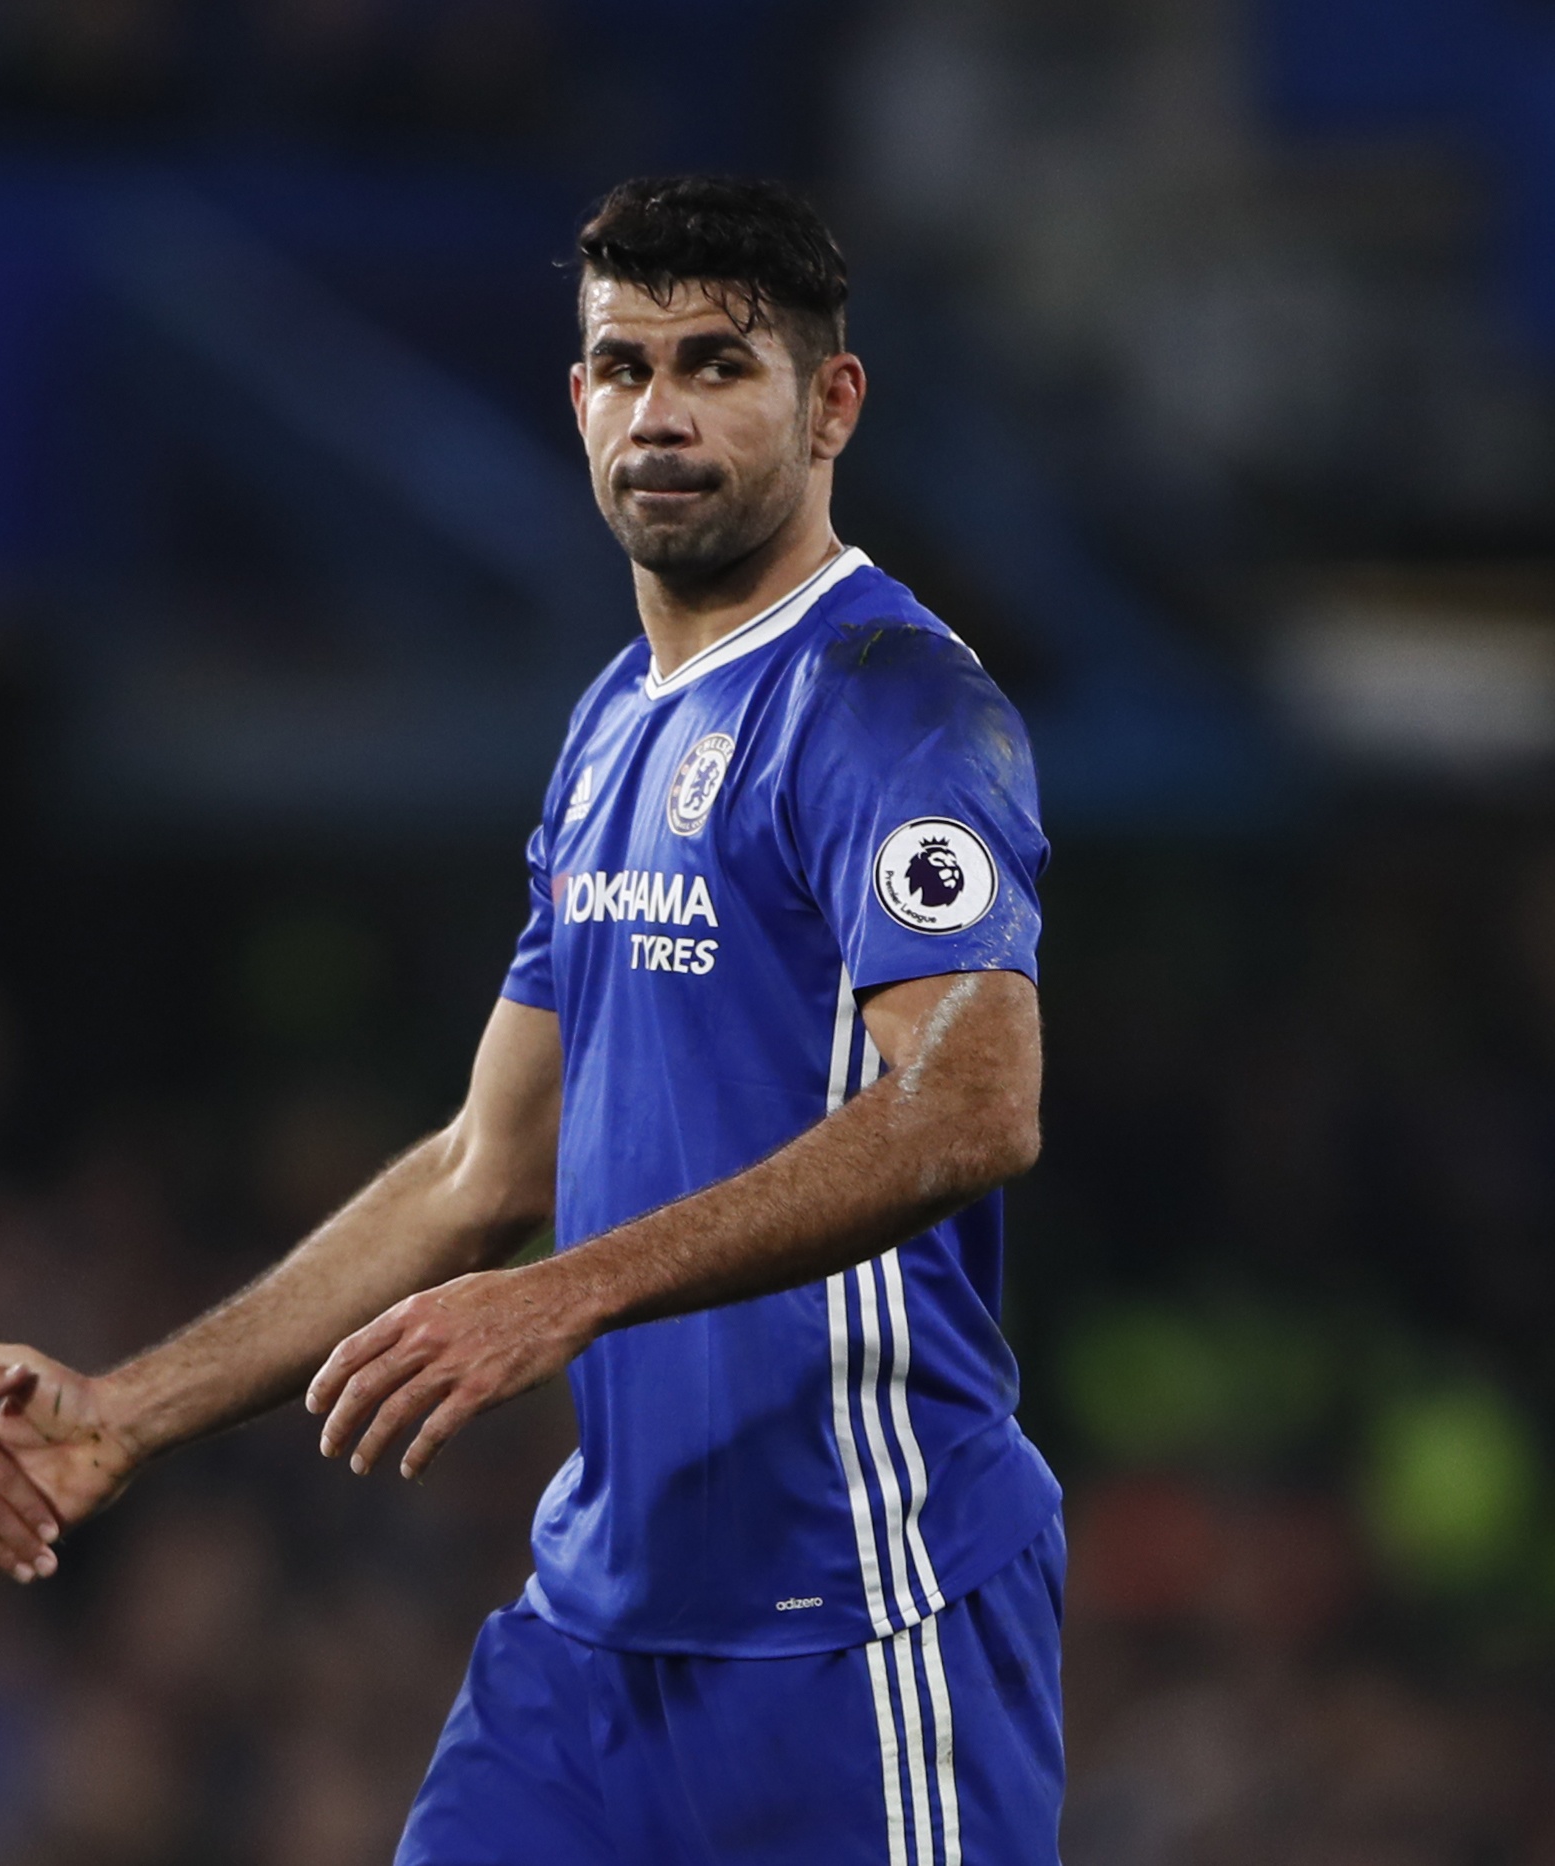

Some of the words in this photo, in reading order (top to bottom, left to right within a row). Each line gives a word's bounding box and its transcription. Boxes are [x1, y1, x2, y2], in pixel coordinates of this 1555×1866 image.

[695, 735, 735, 762] CHELSE
[563, 869, 719, 928] YOKHAMA
[900, 903, 937, 923] League
[630, 933, 720, 976] TYRES
[775, 1597, 824, 1612] adizero
